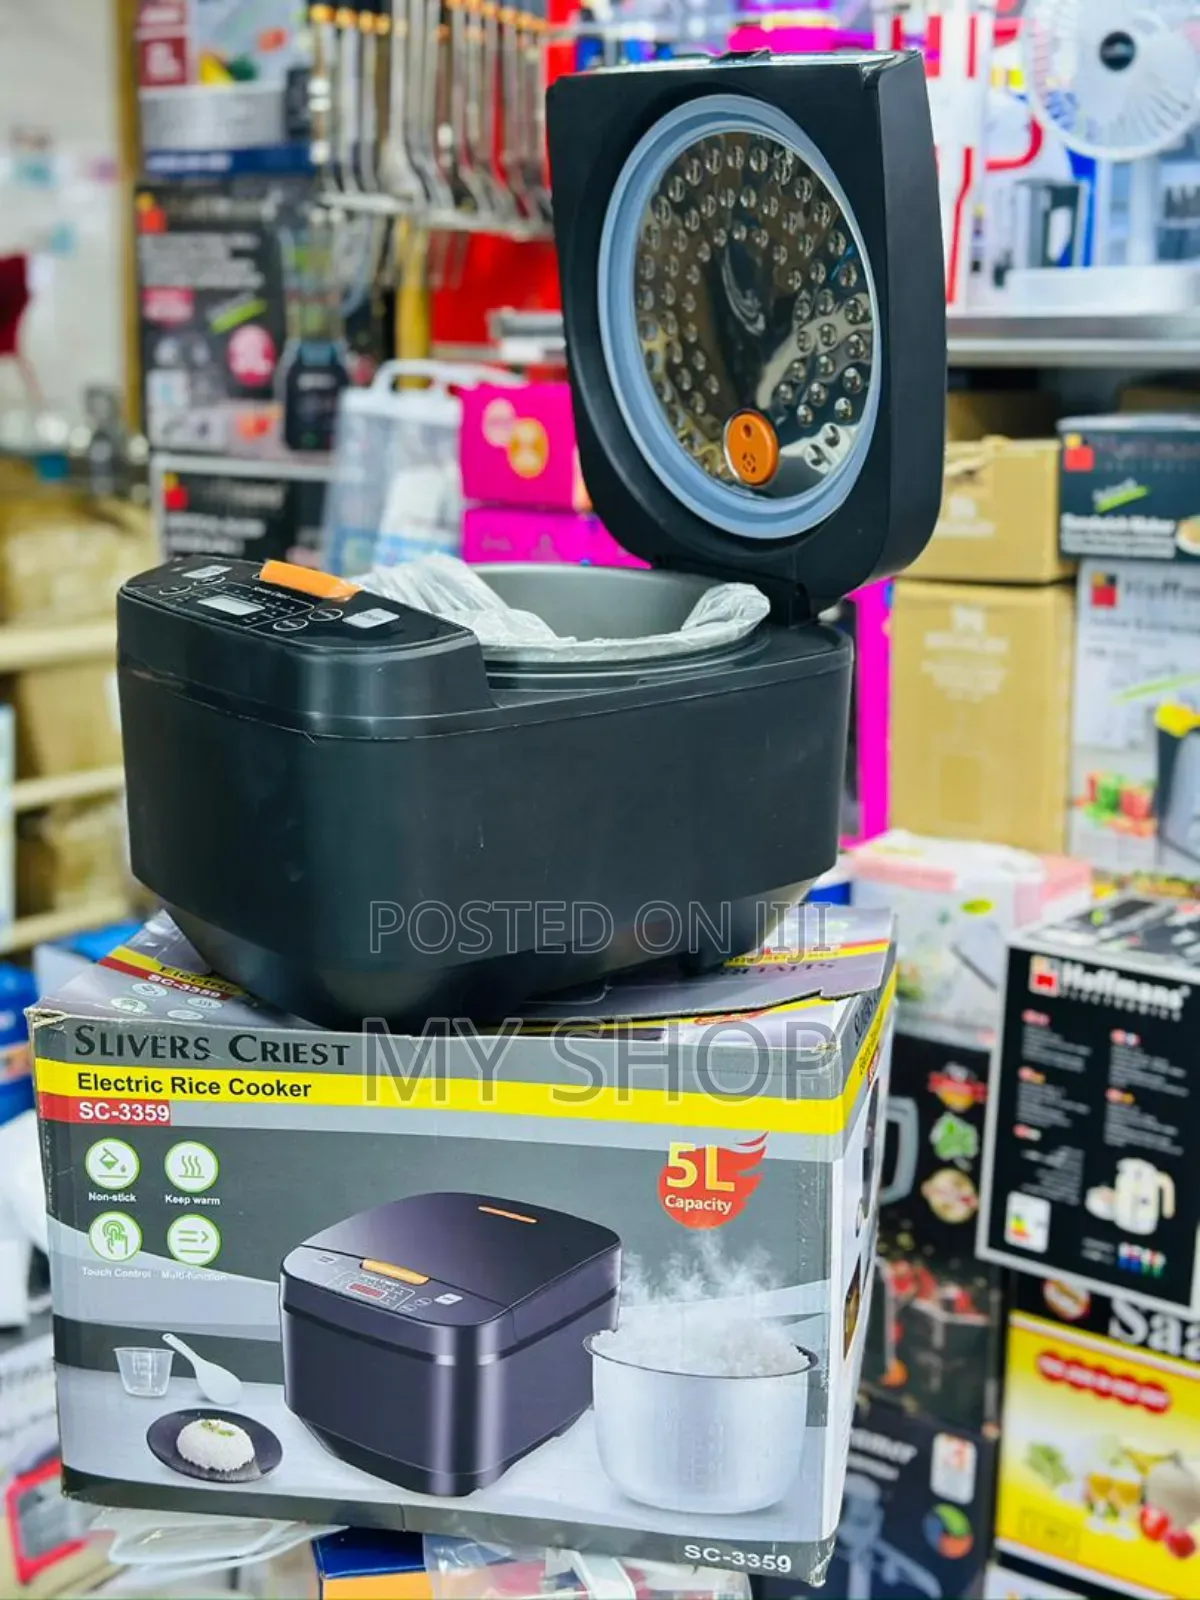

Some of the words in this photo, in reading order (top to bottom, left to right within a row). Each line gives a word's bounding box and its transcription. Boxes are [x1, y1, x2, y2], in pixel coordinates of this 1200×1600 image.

[75, 1025, 210, 1060] SLIVERS
[229, 1033, 350, 1066] CRIEST
[78, 1072, 163, 1093] Electric
[171, 1077, 220, 1095] Rice
[229, 1078, 312, 1097] Cooker
[79, 1102, 170, 1121] SC-3359
[666, 1141, 735, 1192] 5L
[88, 1191, 137, 1203] Non-stick
[164, 1193, 191, 1206] Keep
[192, 1196, 221, 1206] warm
[664, 1194, 733, 1215] Capacity
[81, 1266, 112, 1277] Touch
[684, 1544, 792, 1573] SC-3359
